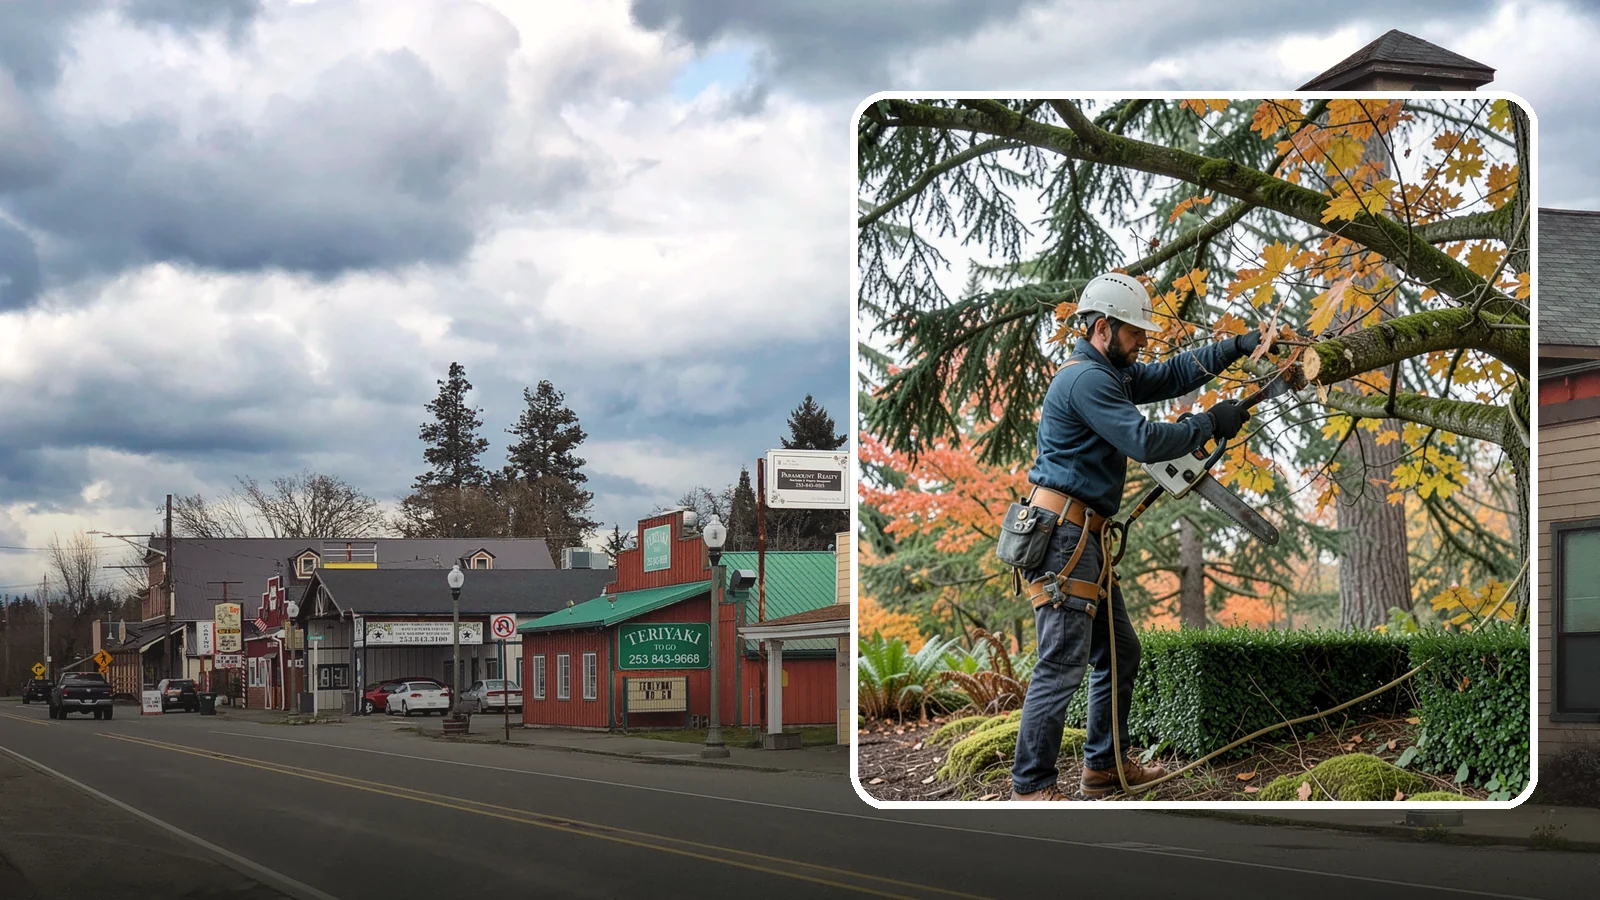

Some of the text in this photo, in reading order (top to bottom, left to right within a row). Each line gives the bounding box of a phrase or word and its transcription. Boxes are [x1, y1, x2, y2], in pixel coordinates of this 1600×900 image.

[625, 627, 702, 646] TERIYAKI
[629, 653, 700, 665] 253 843-9668
[639, 681, 672, 691] TERIYAKI
